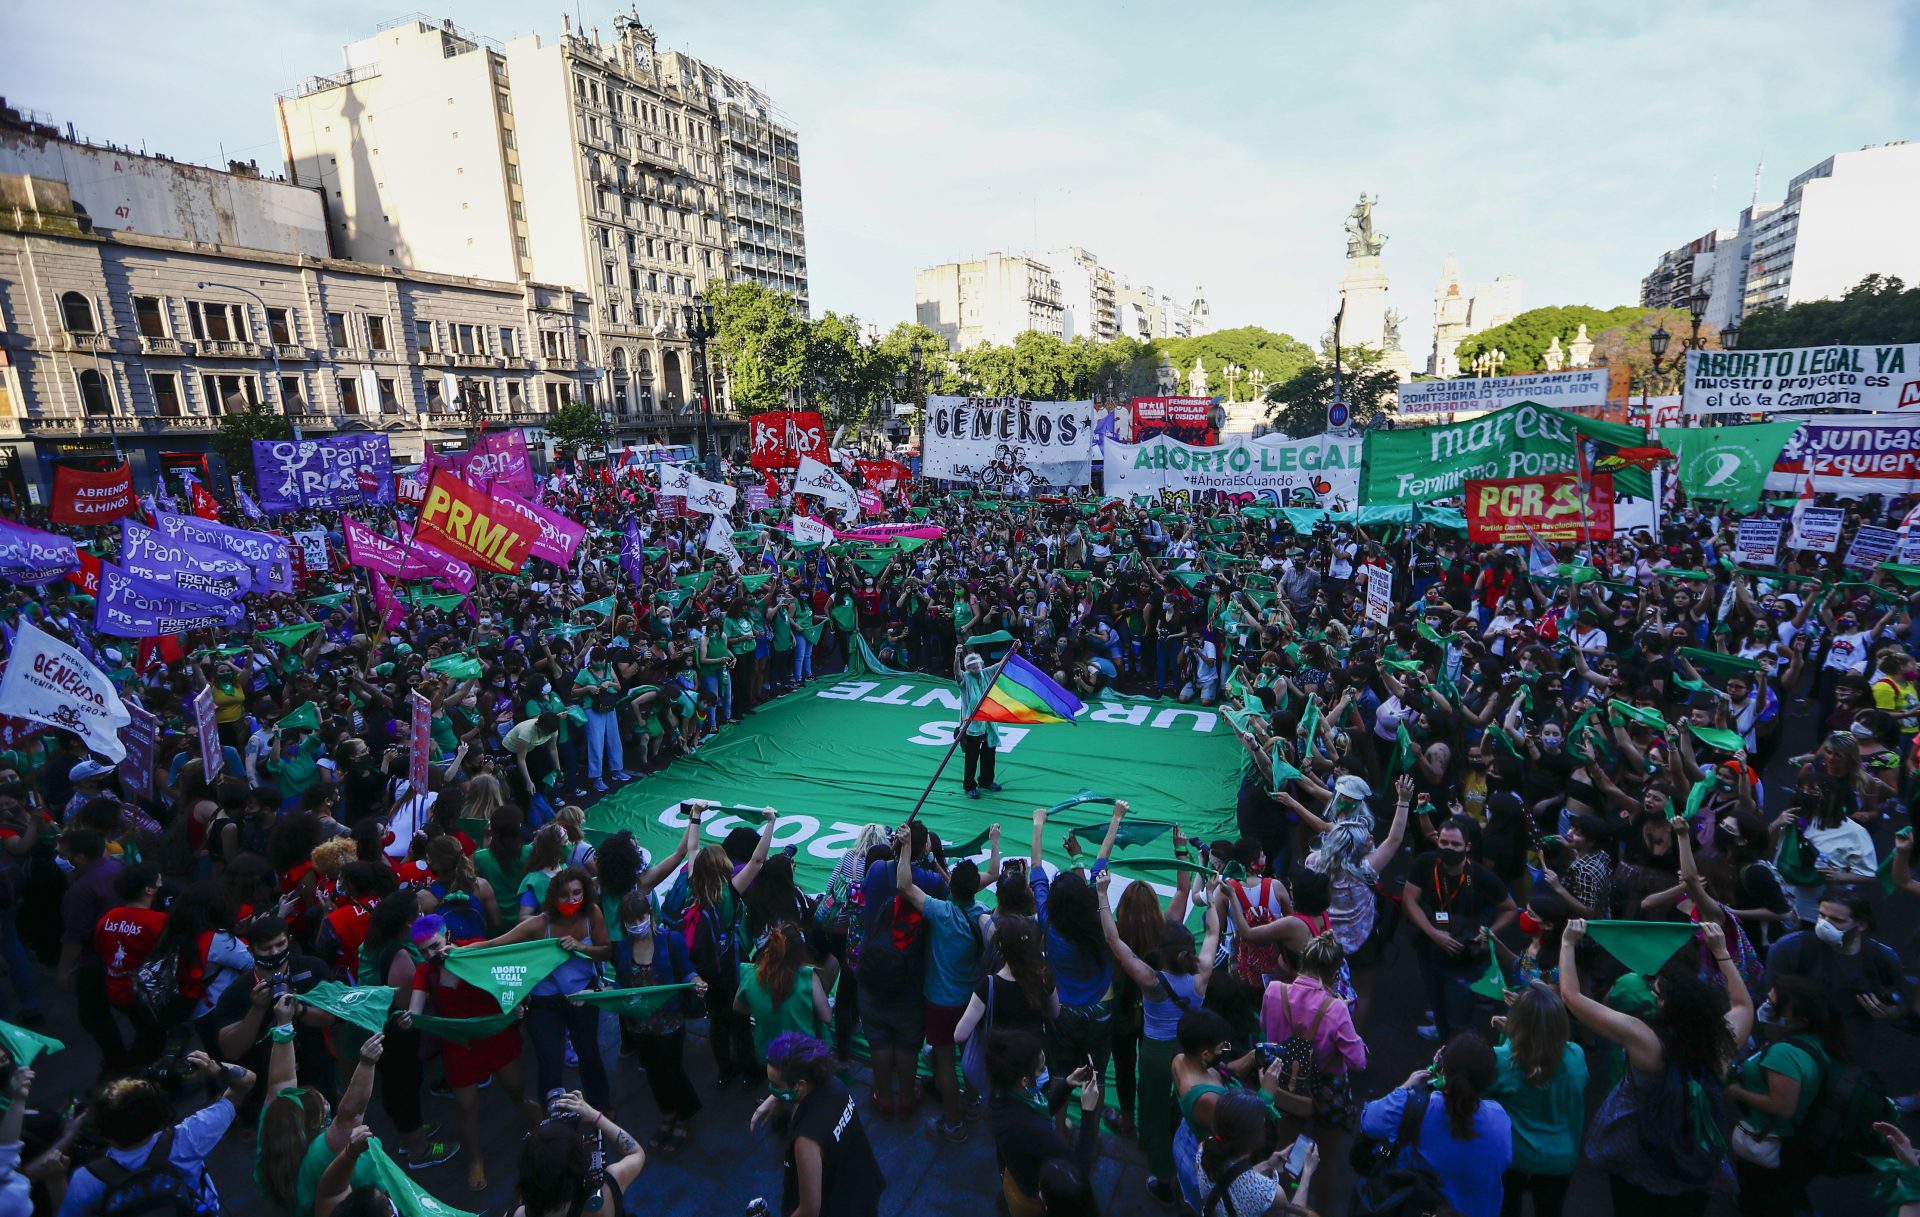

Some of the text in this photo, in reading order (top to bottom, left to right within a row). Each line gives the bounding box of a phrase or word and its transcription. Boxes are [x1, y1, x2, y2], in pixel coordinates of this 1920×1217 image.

[115, 206, 130, 218] 47
[1695, 347, 1905, 378] ABORTO LEGAL YA
[1694, 371, 1890, 392] nuestro proyecto es
[967, 397, 1033, 412] FRENTE DE
[1706, 387, 1861, 407] el de la Campaña
[1133, 444, 1361, 473] ABORTO LEGAL
[953, 463, 972, 477] LA
[76, 480, 129, 497] ABRIENDO
[1191, 474, 1293, 487] #AhoraEsCuando
[74, 497, 129, 513] CAMINOS
[308, 496, 332, 507] PTS
[1478, 482, 1545, 518] PCR
[422, 485, 520, 571] PRML
[130, 565, 154, 580] PTS
[108, 608, 132, 625] PTS
[61, 653, 83, 673] FRENTE
[104, 918, 143, 937] Las Rojas
[490, 965, 527, 974] ABORTO
[495, 973, 523, 982] LEGAL
